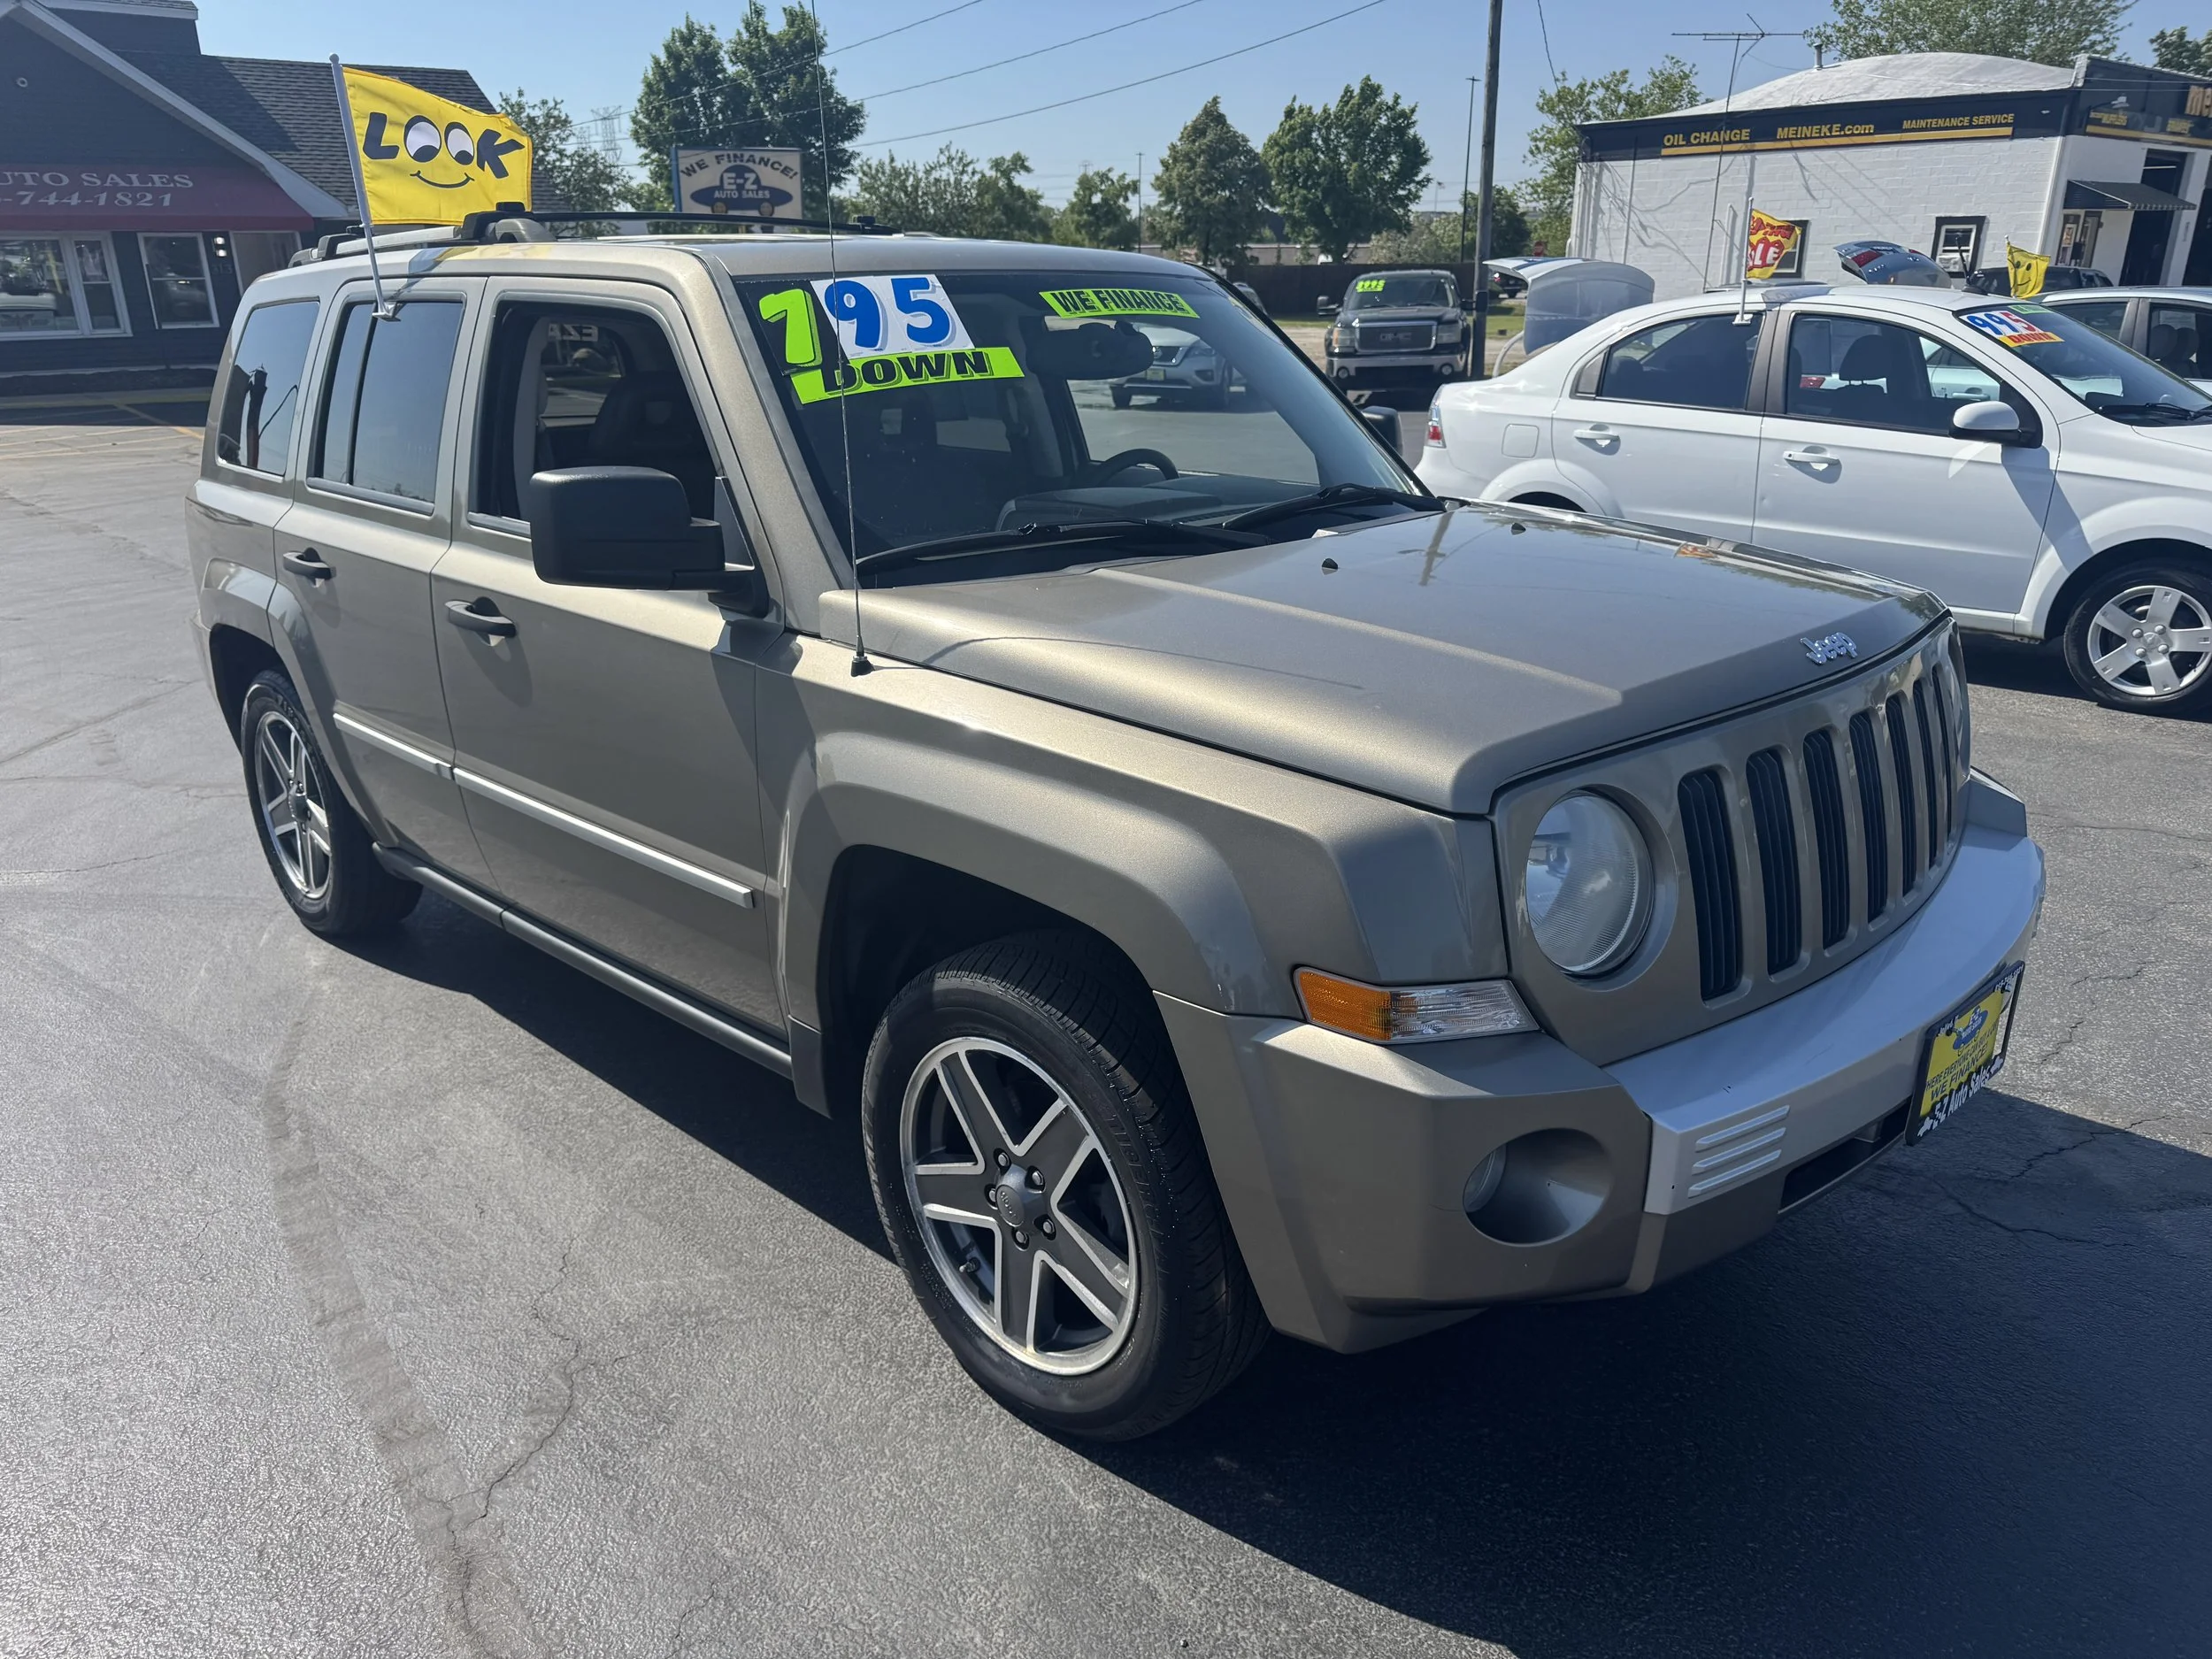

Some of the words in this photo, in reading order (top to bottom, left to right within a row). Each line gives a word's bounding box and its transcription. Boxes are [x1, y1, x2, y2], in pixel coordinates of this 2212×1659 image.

[1902, 117, 1970, 129] MAINTENANCE
[1972, 113, 2015, 126] SERVICE
[1663, 134, 1686, 146] OIL
[1690, 128, 1751, 144] CHANGE
[1777, 124, 1875, 139] MEINEKE.com
[363, 111, 526, 179] LOOK
[680, 158, 710, 177] WE
[715, 152, 799, 180] FINANCE!
[81, 173, 194, 188] SALES
[723, 172, 758, 190] E-Z
[0, 191, 172, 207] -744-1821
[741, 190, 771, 199] SALES
[1050, 290, 1098, 313] WE
[1092, 289, 1188, 313] FINANCE
[1967, 311, 2037, 335] 995
[2007, 332, 2056, 344] DOWN
[821, 351, 995, 395] DOWN
[1800, 632, 1858, 664] Jeep
[1947, 1082, 1968, 1117] Auto
[1969, 1065, 1992, 1098] Sales
